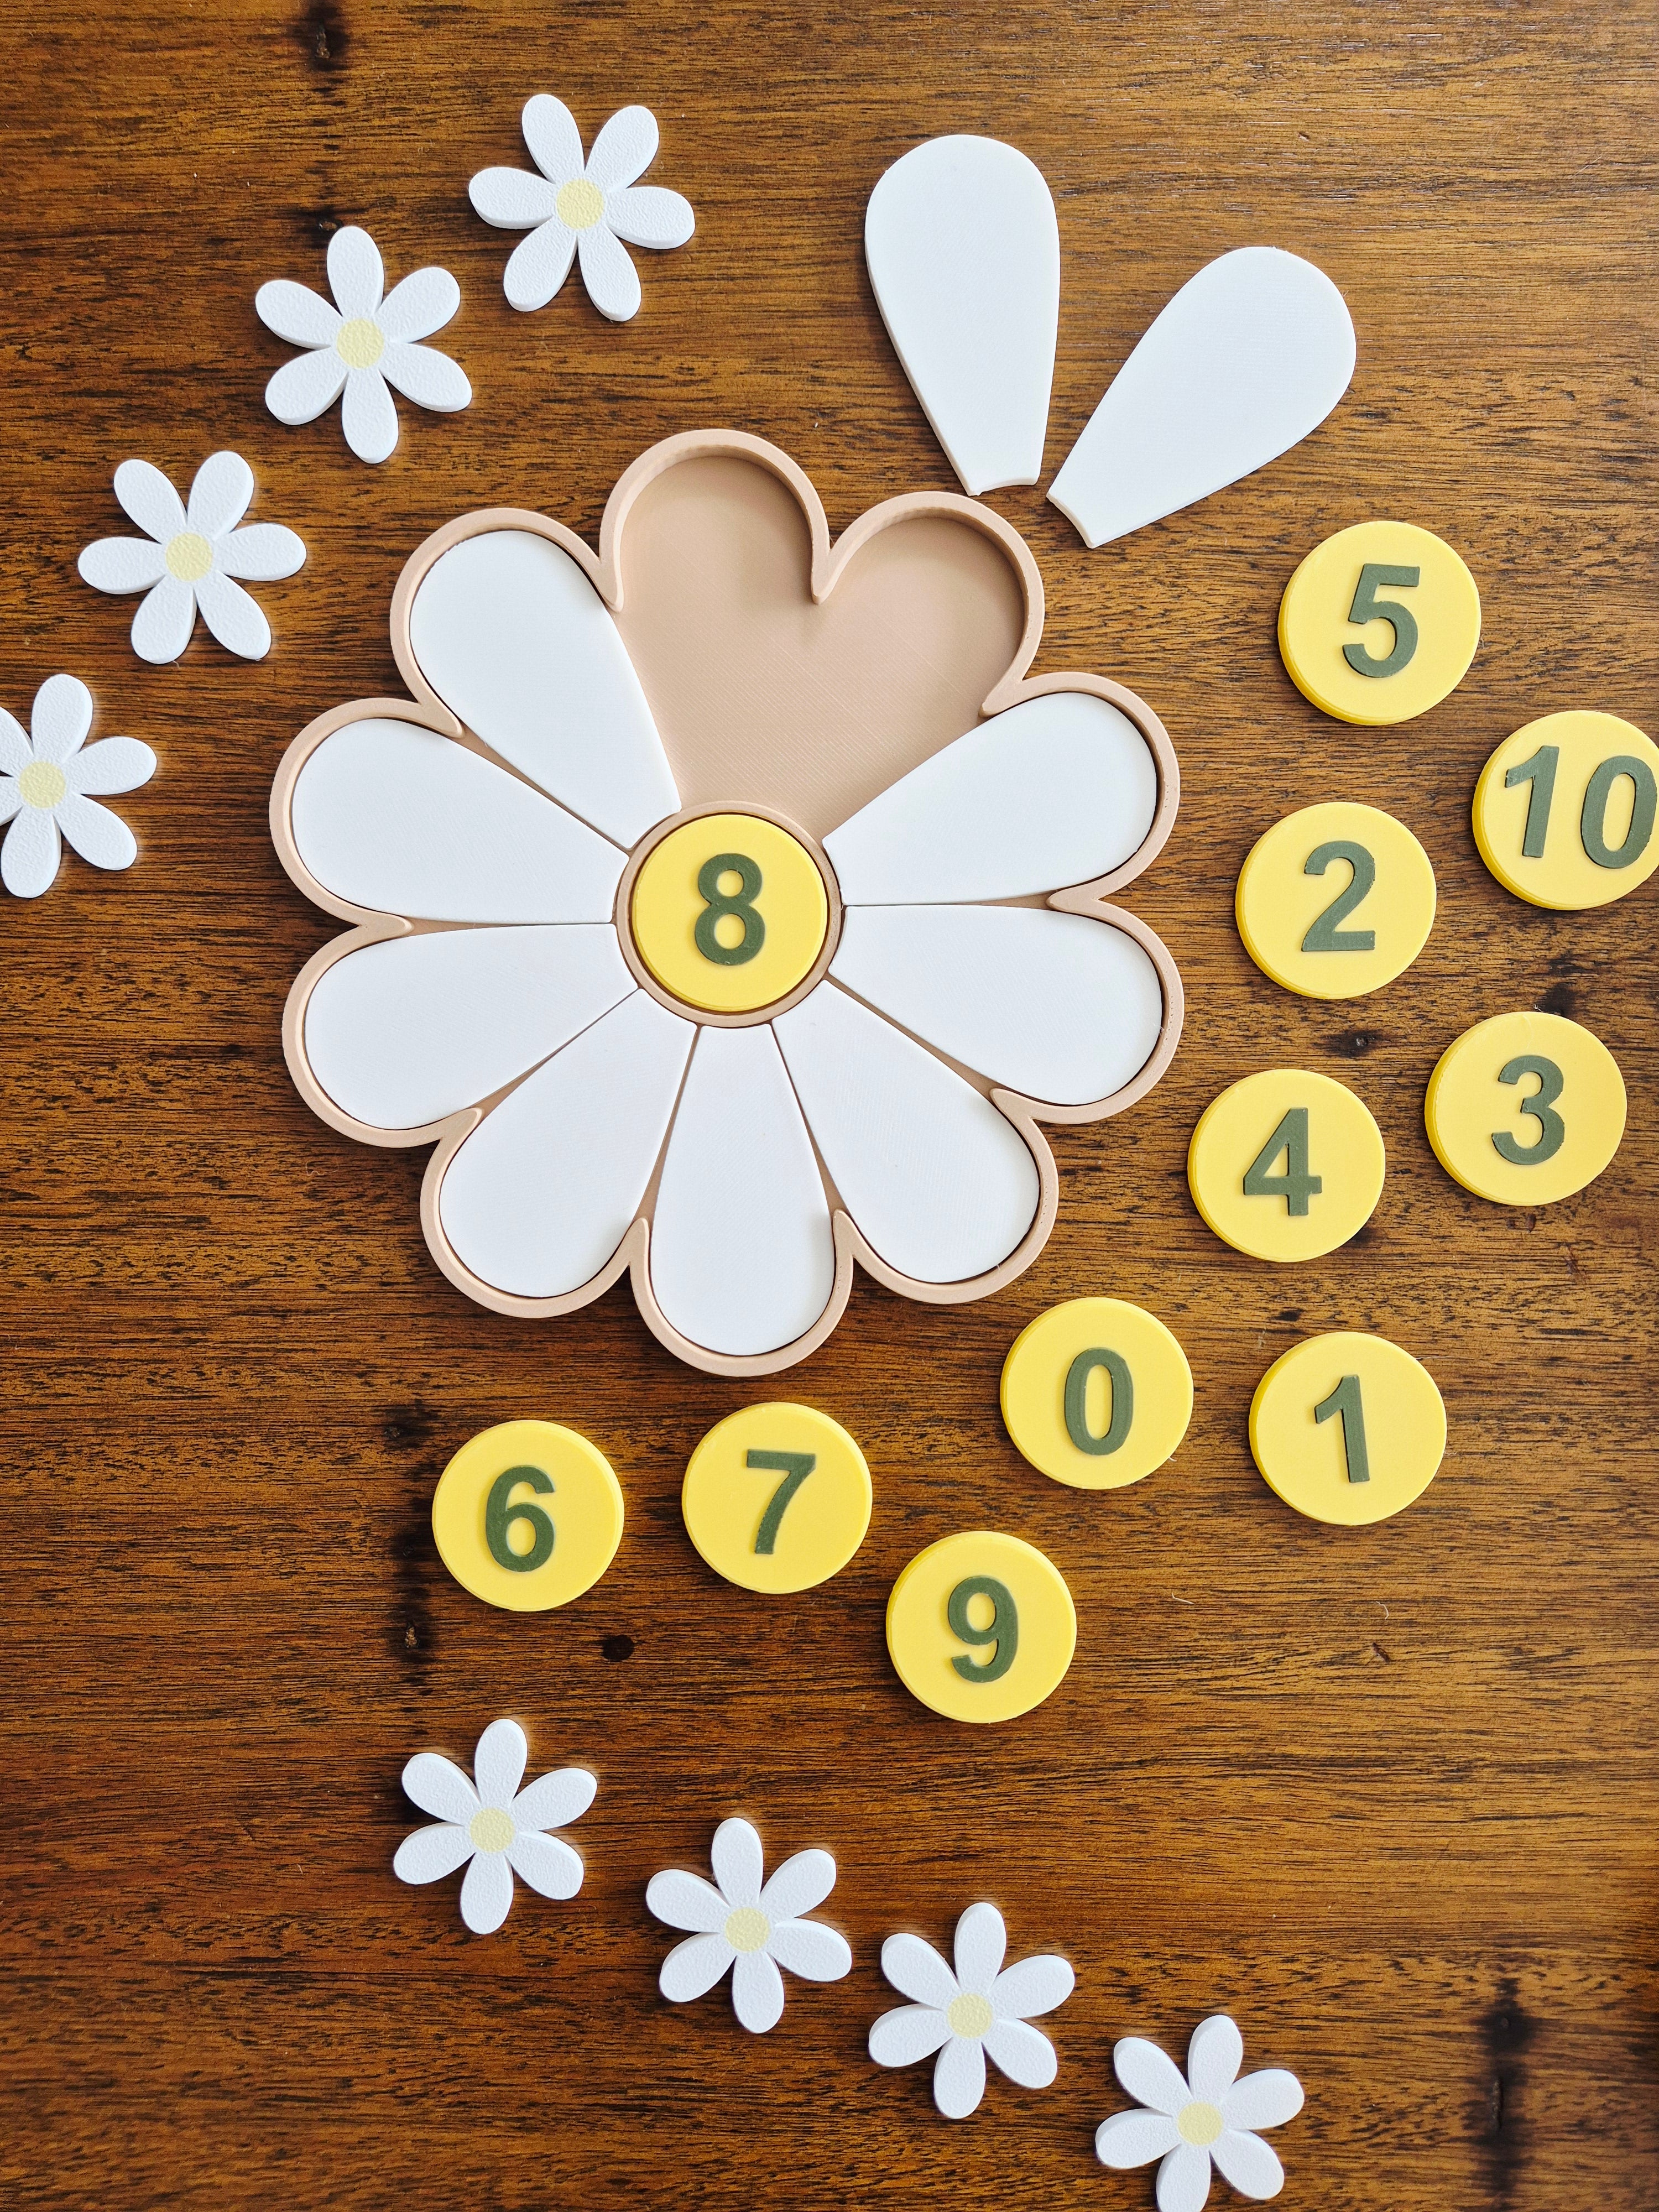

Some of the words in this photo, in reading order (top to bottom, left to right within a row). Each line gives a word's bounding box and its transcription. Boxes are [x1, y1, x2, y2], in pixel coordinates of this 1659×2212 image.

[1343, 564, 1420, 677] 5
[1504, 745, 1657, 869] 10
[695, 853, 765, 966] 8
[1302, 841, 1375, 951] 2
[1243, 1109, 1321, 1215] 4
[1491, 1056, 1564, 1165] 3
[1065, 1348, 1134, 1455] 0
[1314, 1375, 1369, 1483] 1
[486, 1465, 555, 1572] 6
[747, 1449, 816, 1554] 7
[948, 1575, 1019, 1683] 9
